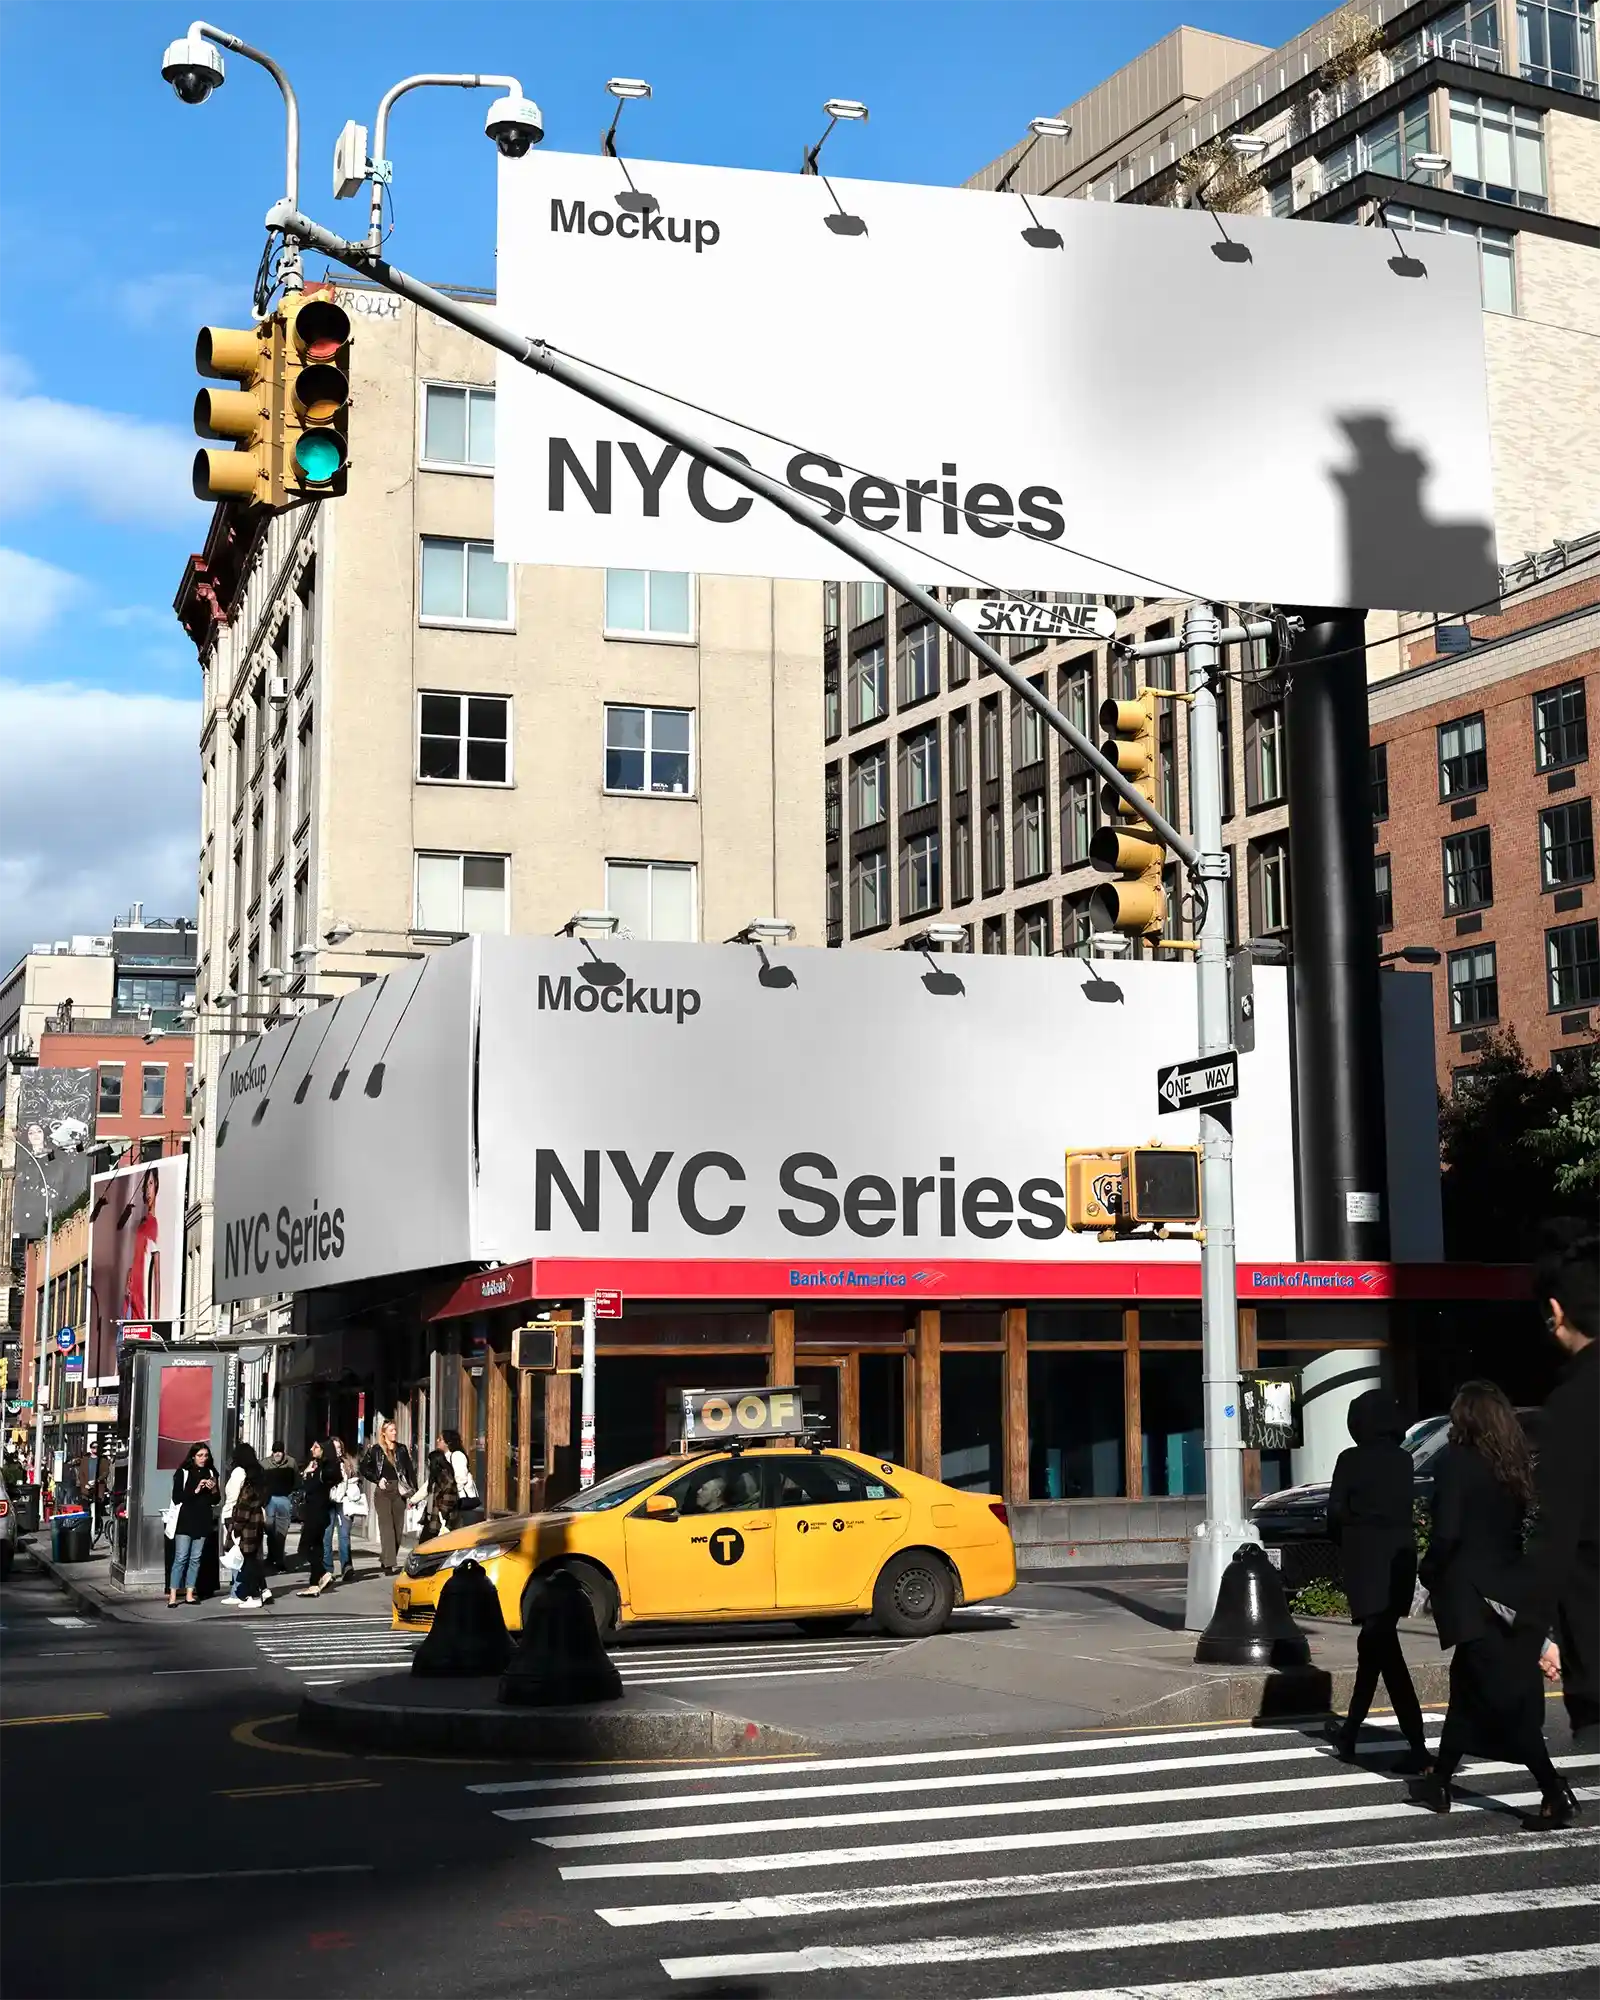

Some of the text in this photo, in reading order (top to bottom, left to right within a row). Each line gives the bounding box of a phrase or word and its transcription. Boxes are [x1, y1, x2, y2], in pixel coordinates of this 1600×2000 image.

[551, 198, 720, 254] Mockup
[549, 437, 1065, 542] NYC Series
[977, 602, 1098, 635] SKYLINE
[538, 975, 701, 1024] Mockup
[230, 1063, 267, 1099] Mockup
[1166, 1066, 1231, 1098] ONE WAY
[534, 1149, 1067, 1240] NYC Series
[225, 1198, 345, 1280] NYC Series
[789, 1270, 907, 1286] Bank of America
[1252, 1272, 1355, 1287] Bank of America
[226, 1353, 238, 1409] Newsstand
[701, 1394, 794, 1432] OOF
[690, 1534, 737, 1561] NYC T
